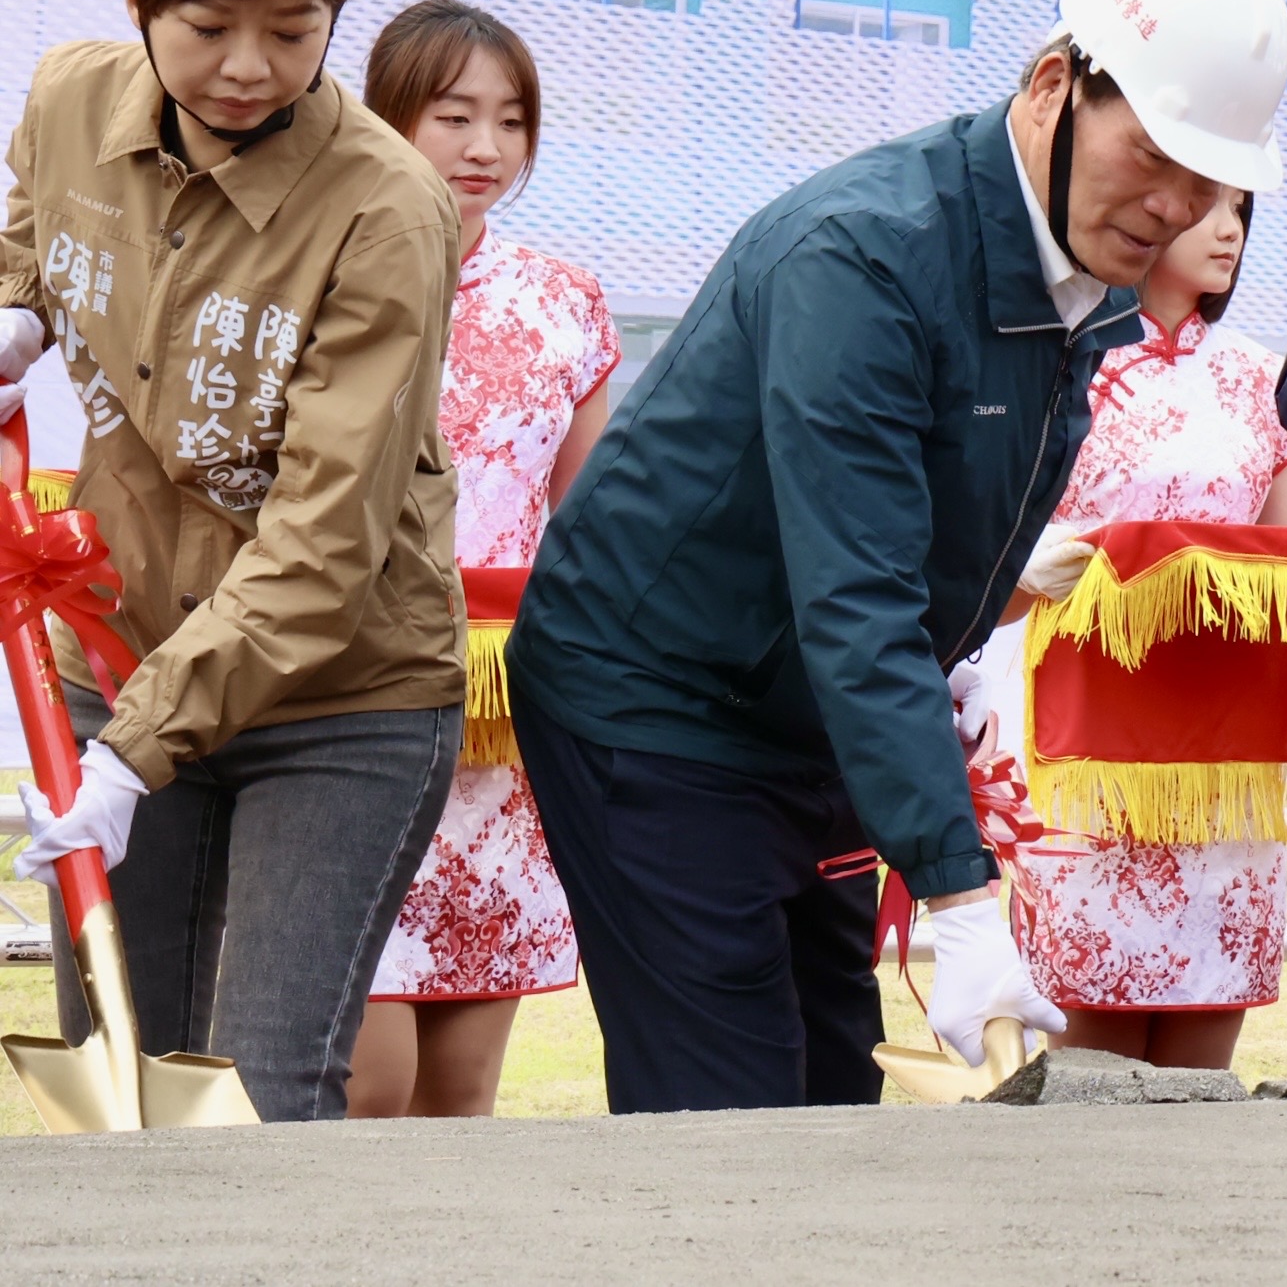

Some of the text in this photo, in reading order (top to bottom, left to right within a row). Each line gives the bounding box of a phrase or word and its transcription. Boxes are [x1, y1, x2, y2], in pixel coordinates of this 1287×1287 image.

[66, 188, 125, 219] MAMMUT
[92, 250, 115, 317] 市議員
[176, 291, 250, 468] 陳怡珍
